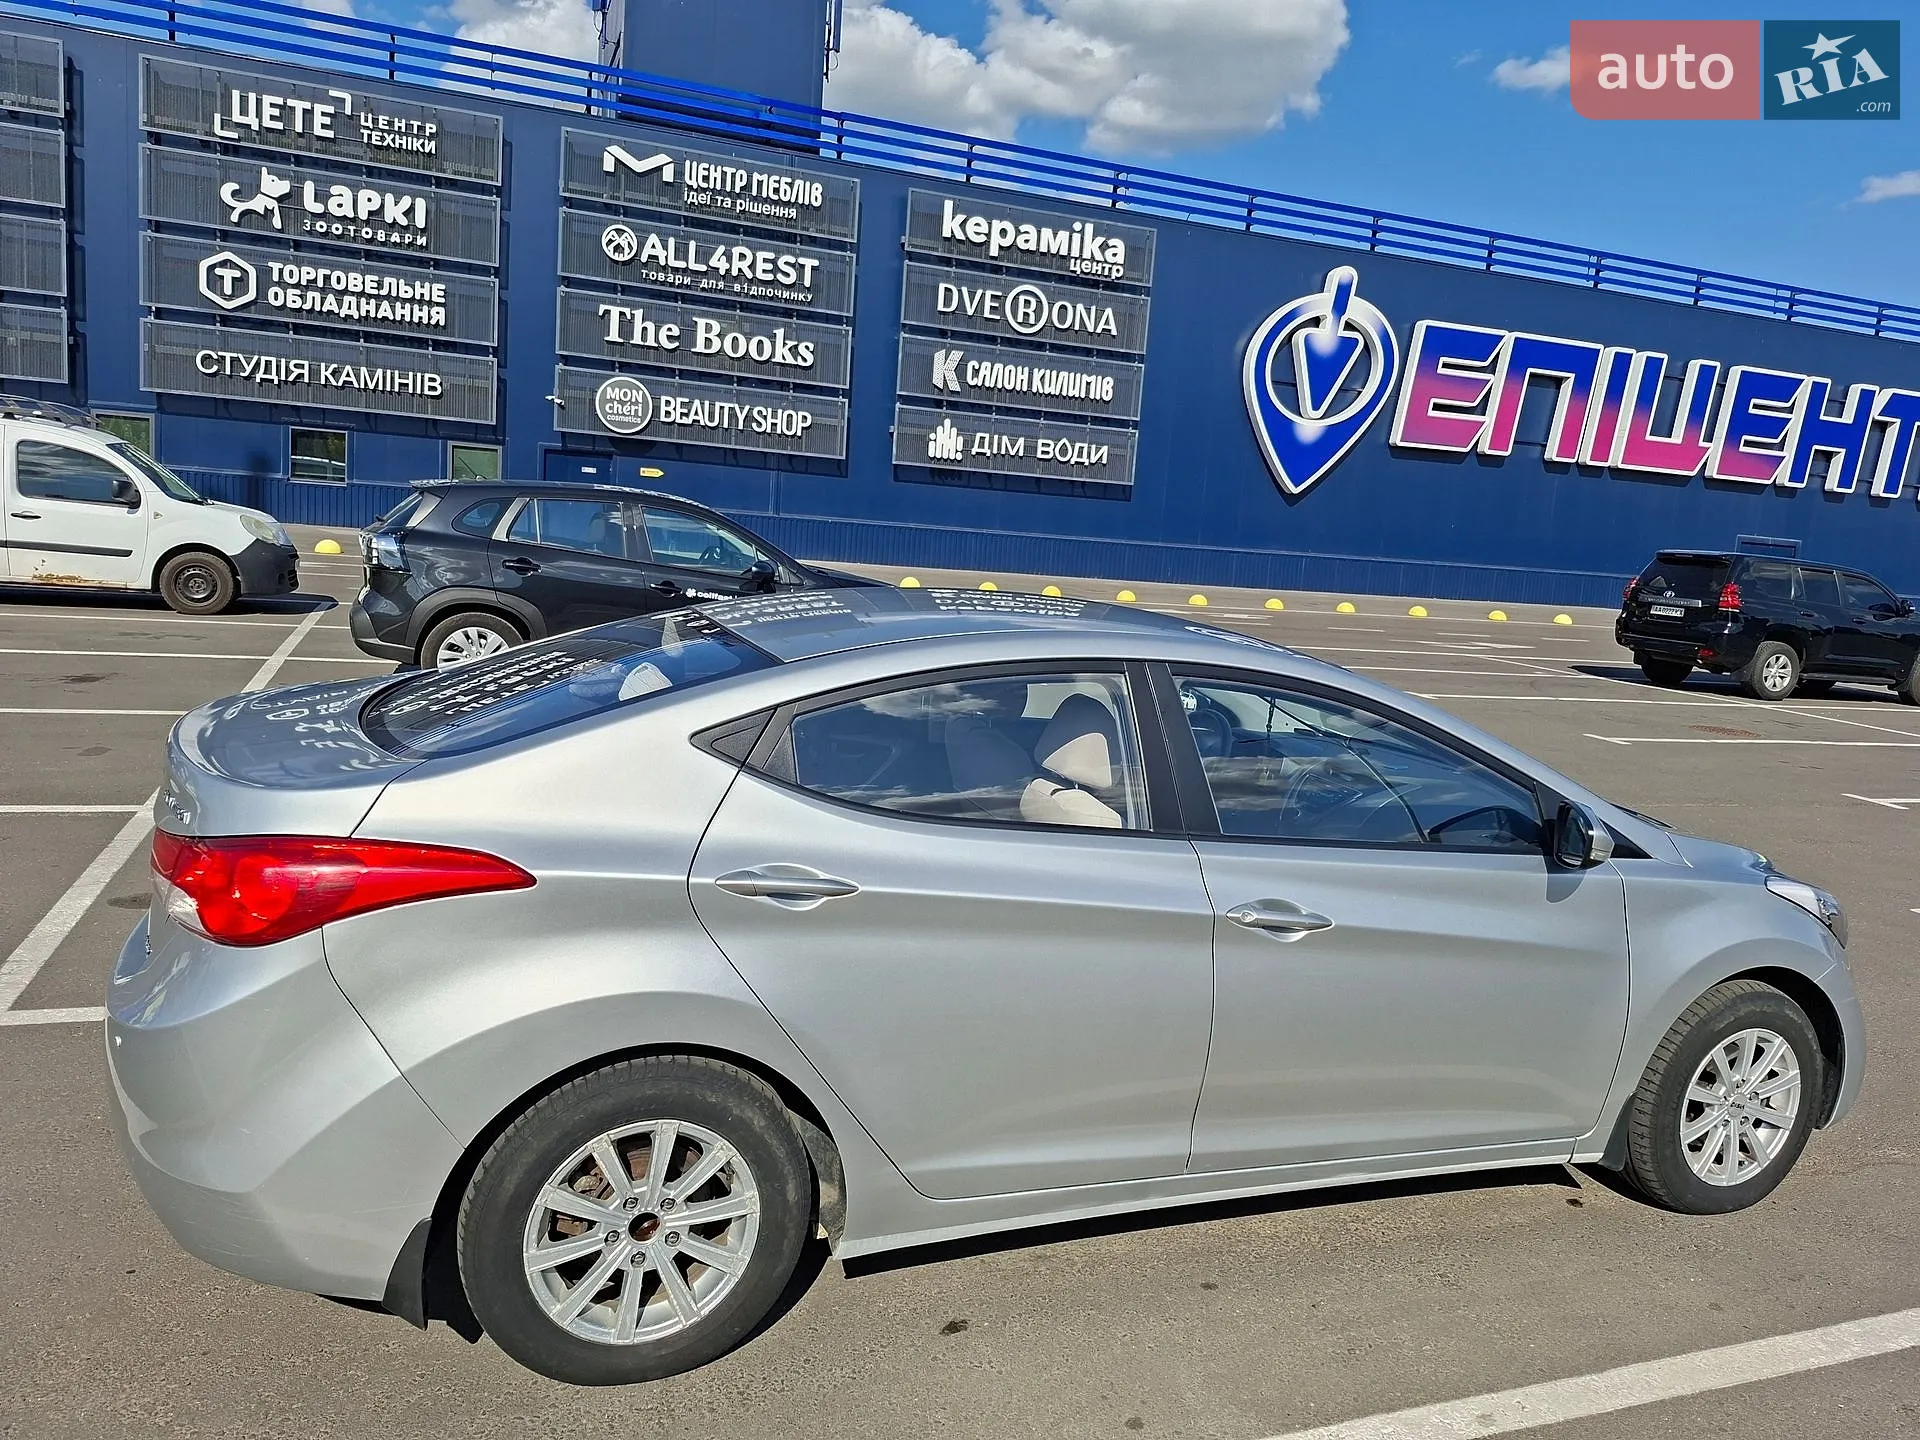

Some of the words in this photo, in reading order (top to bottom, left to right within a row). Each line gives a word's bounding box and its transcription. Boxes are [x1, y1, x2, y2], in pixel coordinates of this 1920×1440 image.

[232, 90, 335, 138] ЦЕТЕ
[360, 111, 437, 137] ЦЕНТР
[360, 129, 436, 154] ТЕХНІКИ
[684, 160, 748, 193] ЦЕНТР
[684, 188, 711, 205] ідеї
[717, 195, 731, 208] та
[736, 198, 797, 219] рішення
[640, 233, 820, 288] ALL4REST
[1069, 258, 1124, 279] центр
[267, 261, 446, 303] ТОРГОВЕЛЬНЕ
[700, 278, 725, 290] для
[733, 282, 814, 302] відпочинку
[267, 286, 446, 326] ОБЛАДНАННЯ
[936, 282, 1118, 336] DVERONA
[598, 304, 680, 350] The
[691, 316, 815, 367] Books
[195, 350, 310, 385] СТУДІЯ
[319, 361, 443, 397] КАМІНІВ
[966, 360, 1029, 392] САЛОН
[605, 400, 643, 417] chéri
[606, 386, 643, 403] MON
[1389, 319, 1920, 499] ЕПІЦЕНТ
[606, 414, 642, 424] cosmetics
[659, 395, 750, 430] BEAUTY
[751, 406, 812, 437] SHOP
[971, 432, 1025, 457] ДІМ
[1036, 437, 1109, 466] ВОДИ
